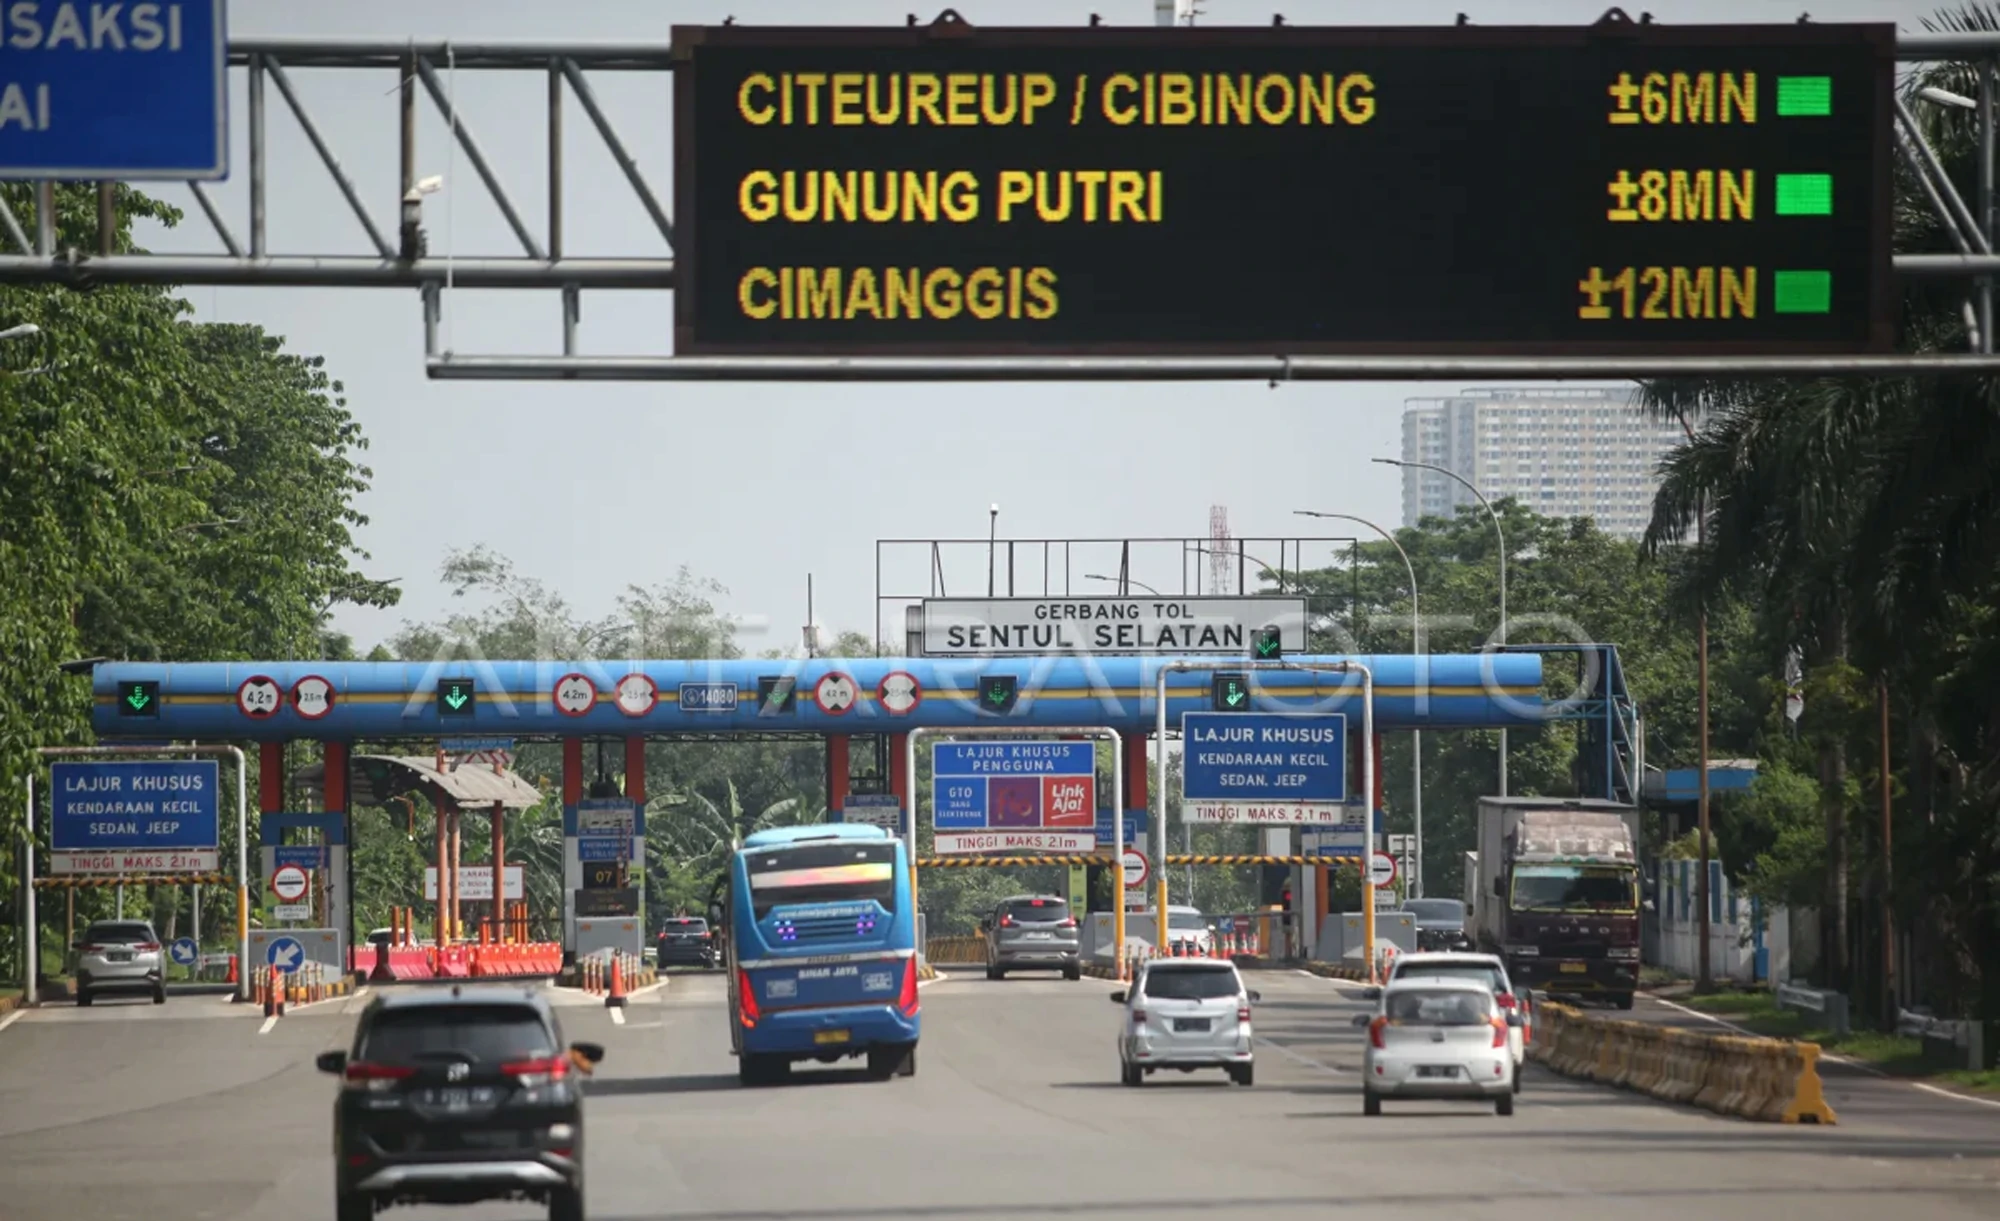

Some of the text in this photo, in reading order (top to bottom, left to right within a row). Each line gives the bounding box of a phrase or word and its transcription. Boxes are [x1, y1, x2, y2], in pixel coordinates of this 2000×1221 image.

[0, 3, 182, 50] SAKSI
[738, 74, 1376, 126] CITEUREUP / CIBINONG
[1608, 72, 1757, 124] ±6MN
[738, 171, 1162, 222] GUNUNG PUTRI
[1607, 169, 1755, 221] ±8MN
[738, 267, 1059, 319] CIMANGGIS
[1579, 266, 1757, 319] ±12MN
[1034, 603, 1194, 620] GERBANG TOL
[947, 624, 1243, 648] SENTUL SELATAN
[701, 689, 733, 704] 14080
[1194, 728, 1335, 743] LAJUR KHUSUS
[957, 746, 1070, 758] LAJUR KHUSUS
[1199, 753, 1329, 766] KENDARAAN KECIL
[973, 760, 1054, 771] PENGGUNA
[65, 775, 203, 792] LAJUR KHUSUS
[1273, 774, 1307, 787] JEEP
[949, 786, 972, 798] GTO
[1052, 784, 1085, 799] Link
[67, 801, 202, 815] KENDARAAN KECIL
[1052, 797, 1082, 813] Aja!
[1196, 807, 1239, 819] TINGGI
[1319, 810, 1331, 821] m
[145, 821, 180, 834] JEEP
[956, 836, 998, 849] TINGGI
[70, 857, 115, 869] TINGGI
[189, 858, 201, 868] m
[595, 871, 612, 883] 07
[1539, 926, 1610, 935] FUSO
